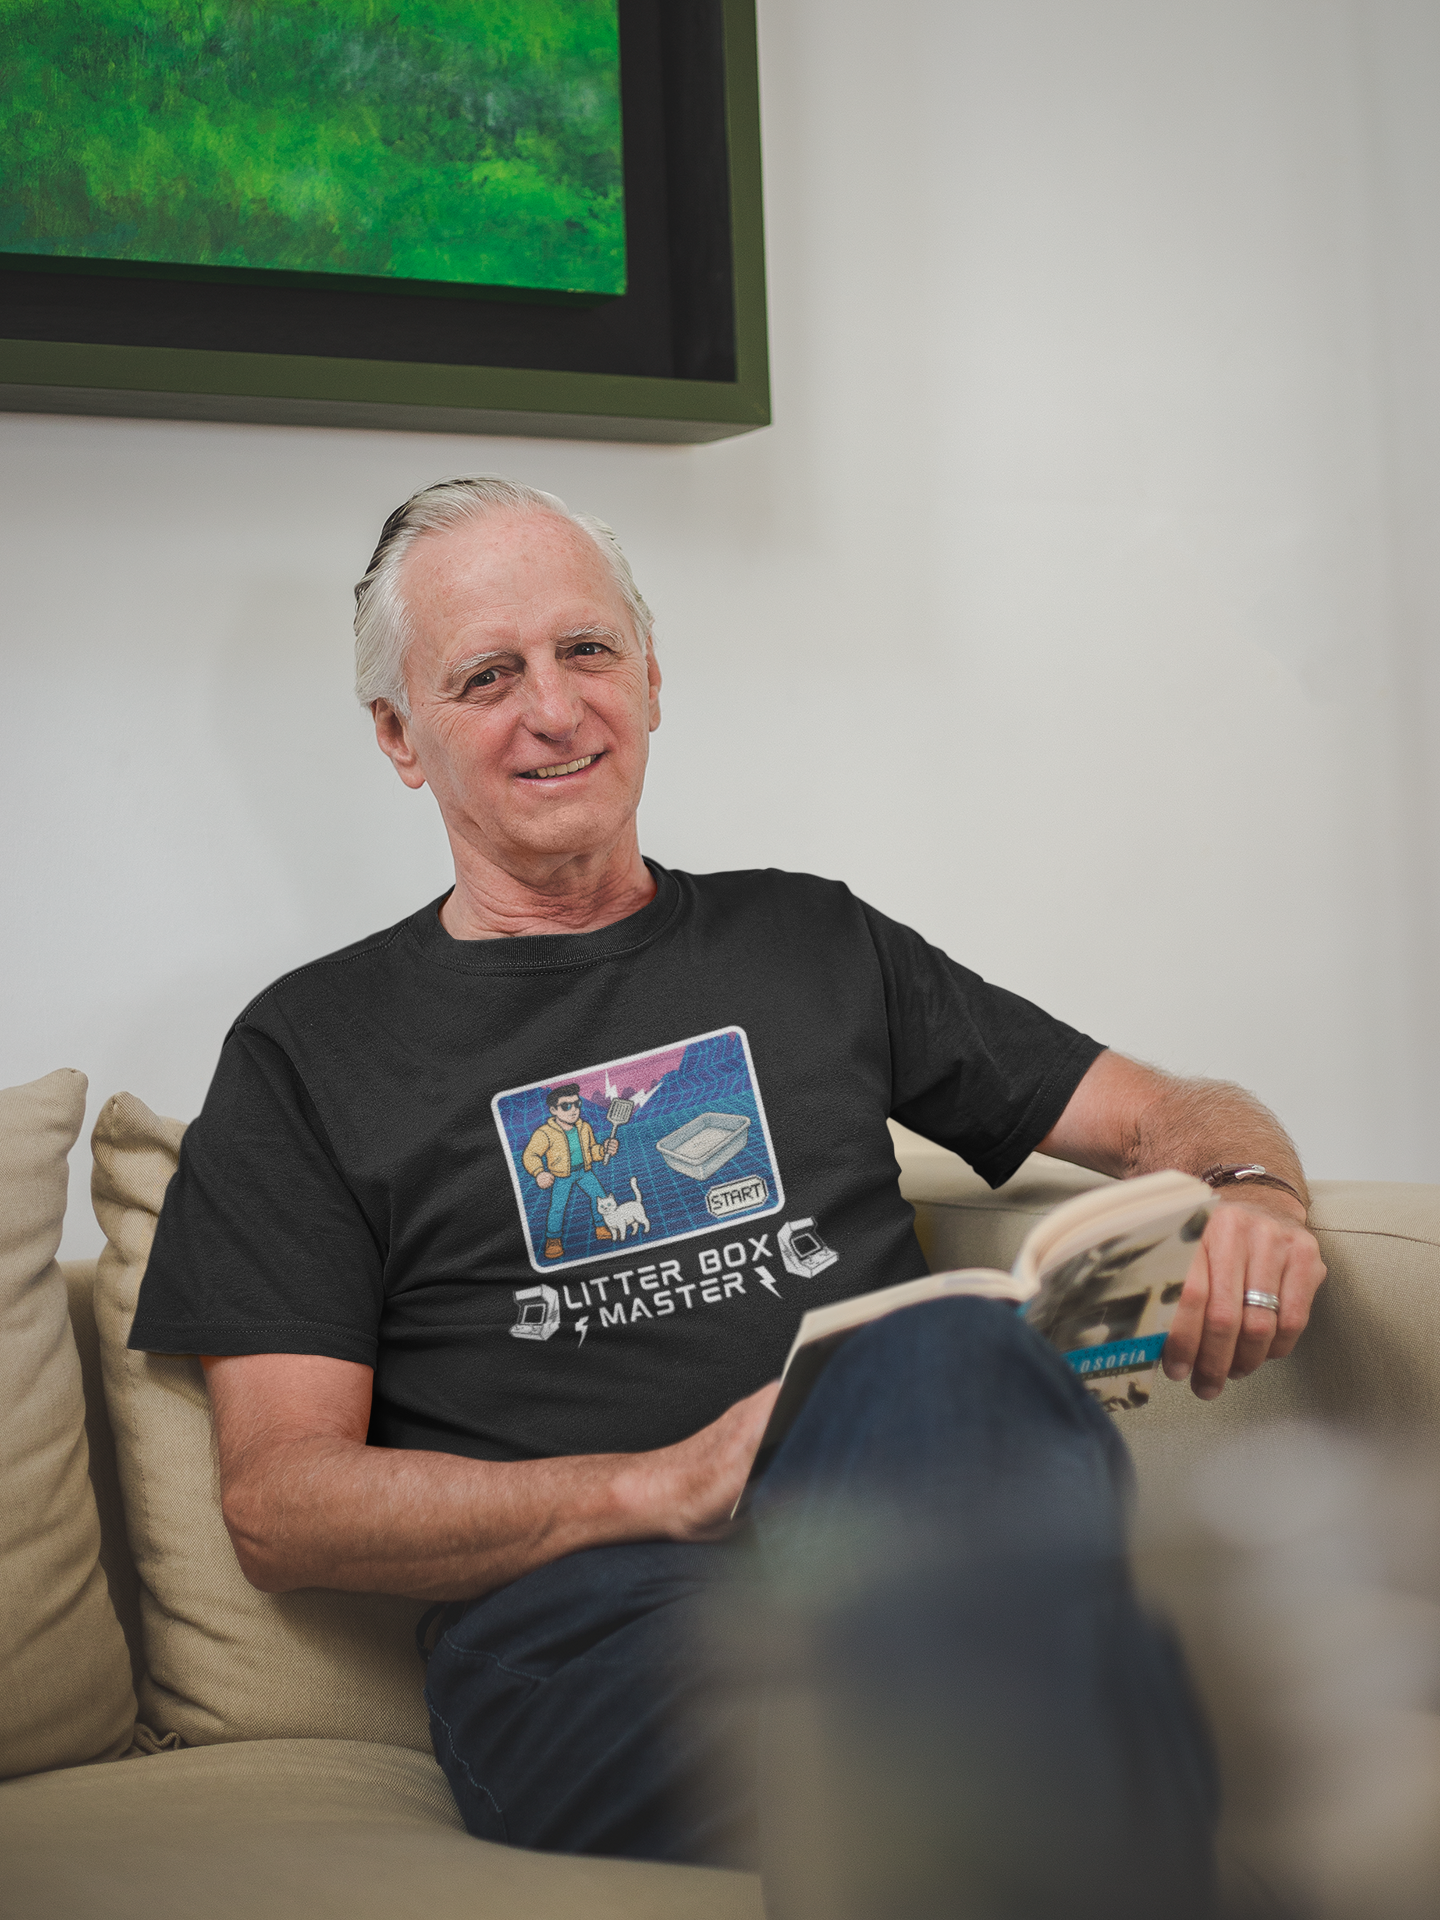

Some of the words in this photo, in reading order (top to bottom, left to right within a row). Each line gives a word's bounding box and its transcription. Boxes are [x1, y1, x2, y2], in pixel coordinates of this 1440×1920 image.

[711, 1182, 761, 1211] START
[563, 1259, 684, 1310] LITTER
[699, 1233, 773, 1275] BOX
[600, 1271, 747, 1328] MASTER
